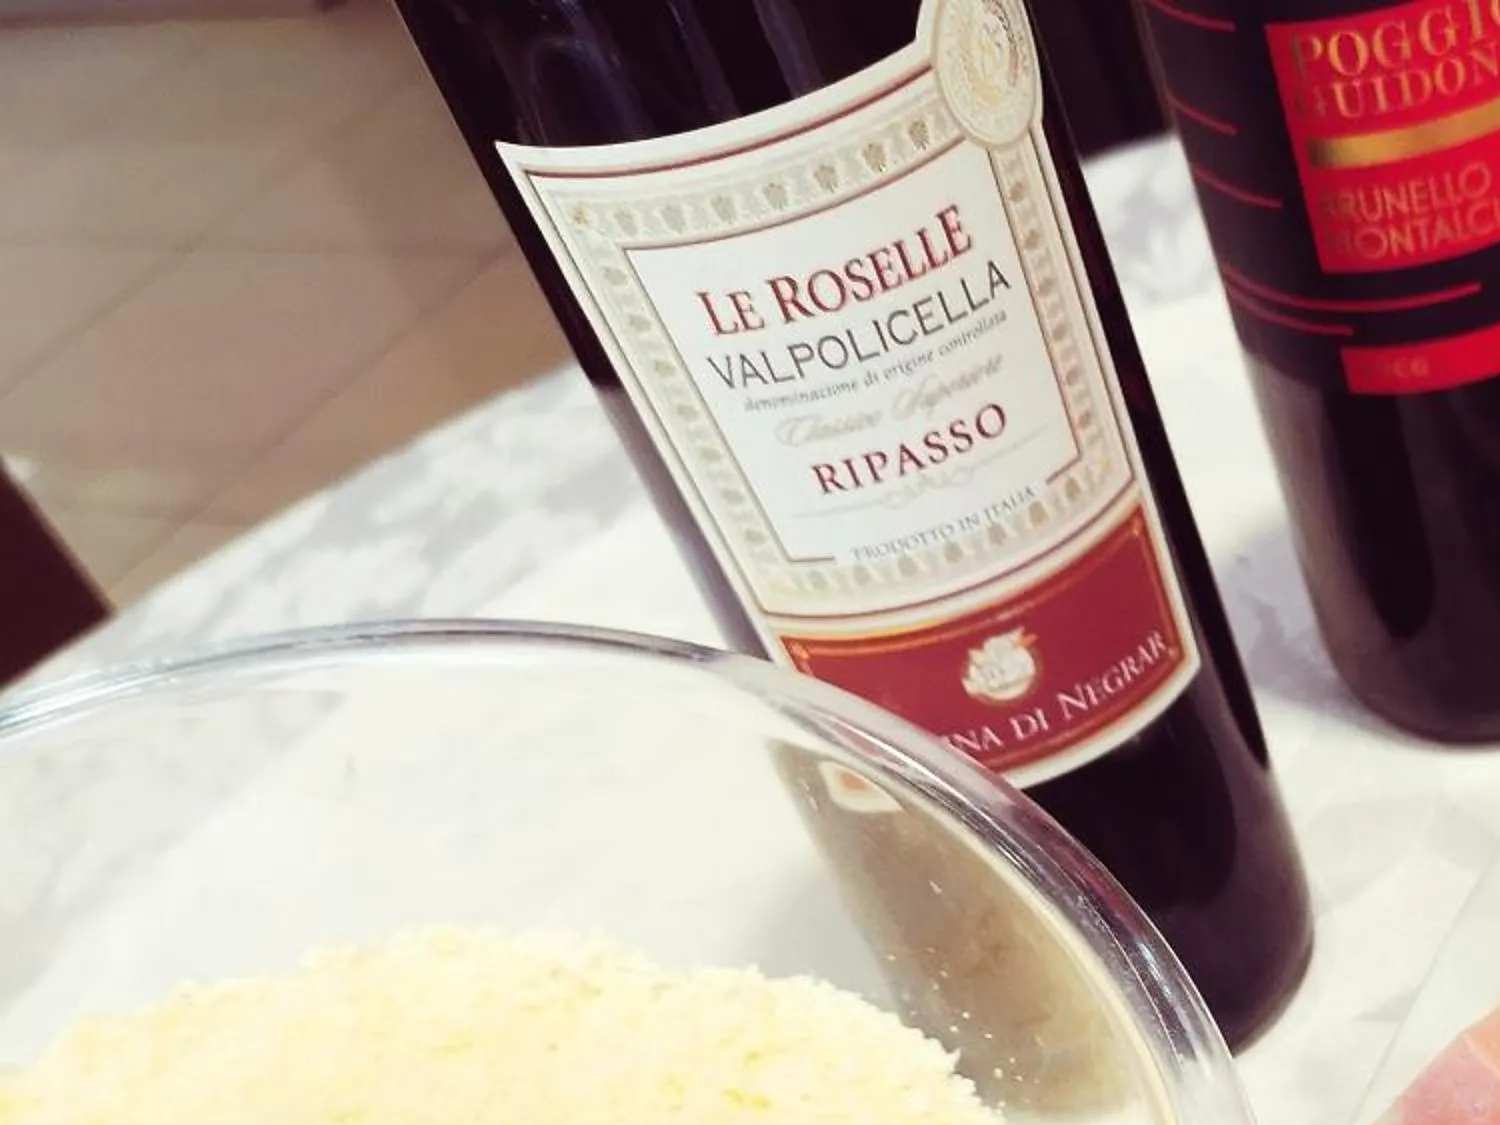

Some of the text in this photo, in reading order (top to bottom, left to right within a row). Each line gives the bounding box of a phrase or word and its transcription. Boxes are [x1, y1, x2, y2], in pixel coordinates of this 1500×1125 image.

[1318, 162, 1491, 223] BRUNELLO
[697, 204, 972, 336] LE ROSELLE
[706, 260, 1012, 389] VALPOLICELLA
[745, 310, 1008, 412] denominazione di origine controllata
[811, 402, 1007, 495] RIPASSO
[852, 486, 1037, 560] PRODOTTO IN ITALIA
[1010, 707, 1049, 741] DI
[1056, 629, 1168, 720] NEGRAR
